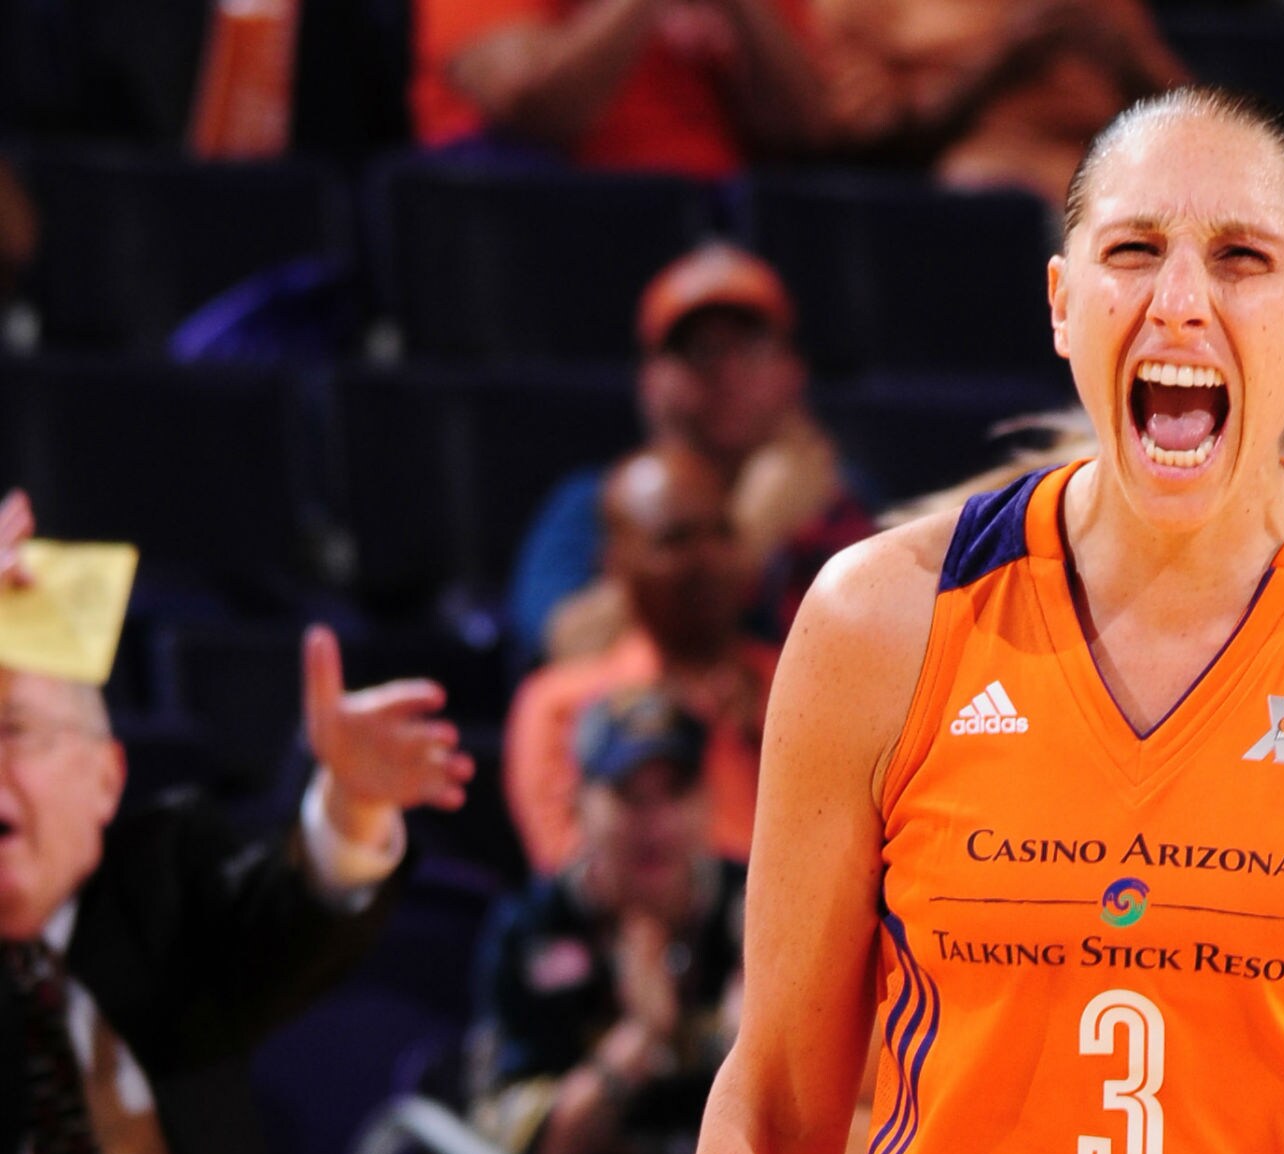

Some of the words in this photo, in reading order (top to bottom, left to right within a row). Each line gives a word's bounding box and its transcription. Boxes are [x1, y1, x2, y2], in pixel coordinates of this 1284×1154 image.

[950, 714, 1029, 735] adidas
[966, 828, 1107, 864] CASINO
[932, 929, 1067, 966] TALKING
[1080, 935, 1183, 971] STICK
